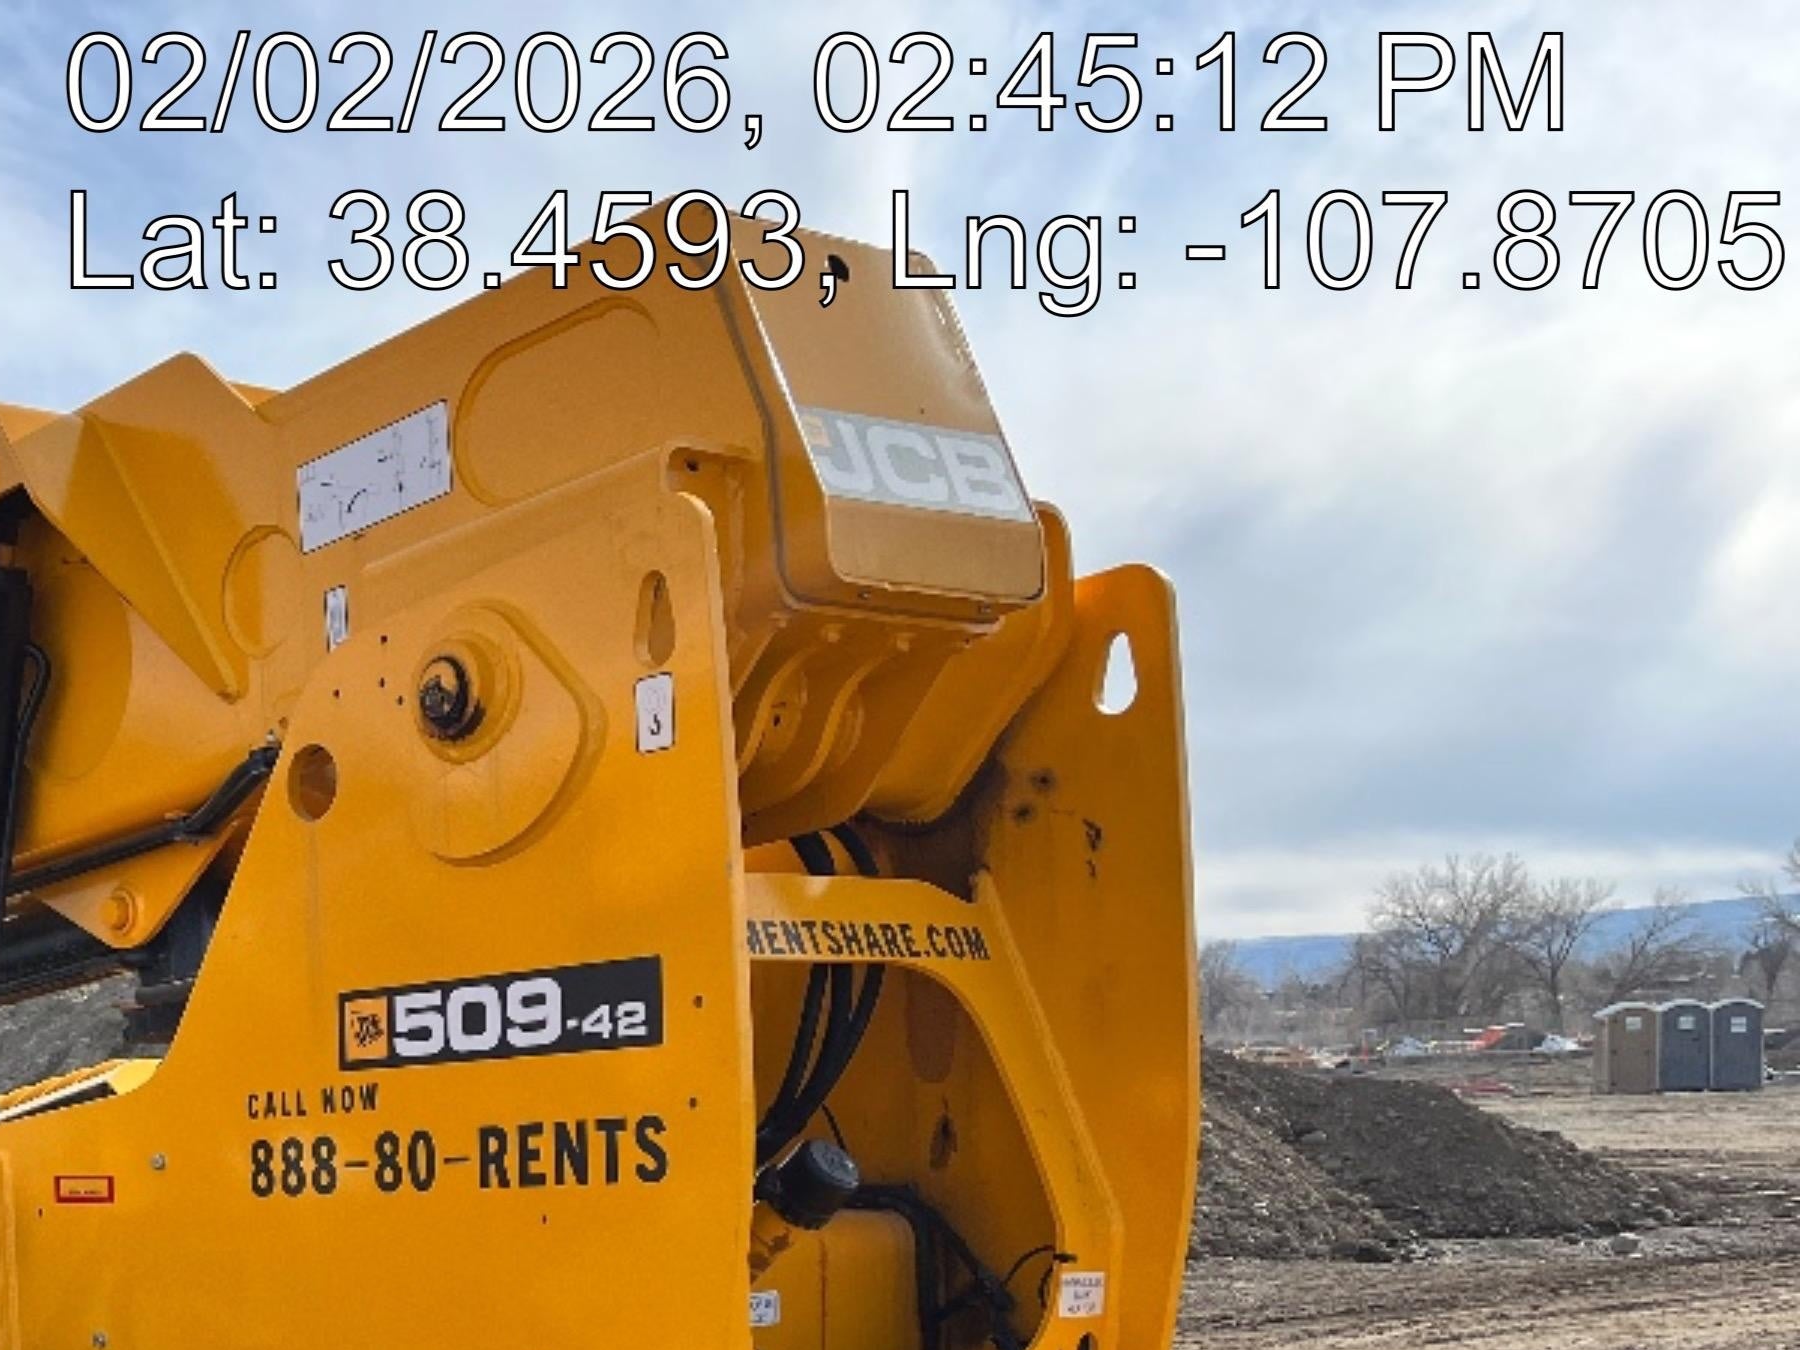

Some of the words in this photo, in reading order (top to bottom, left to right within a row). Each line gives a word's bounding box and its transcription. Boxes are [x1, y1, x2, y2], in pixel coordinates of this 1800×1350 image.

[812, 419, 1022, 511] JCB
[393, 977, 648, 1058] 509-42
[248, 1088, 307, 1119] CALL
[322, 1083, 378, 1112] NOW
[251, 1115, 668, 1198] 888-80-RENTS
